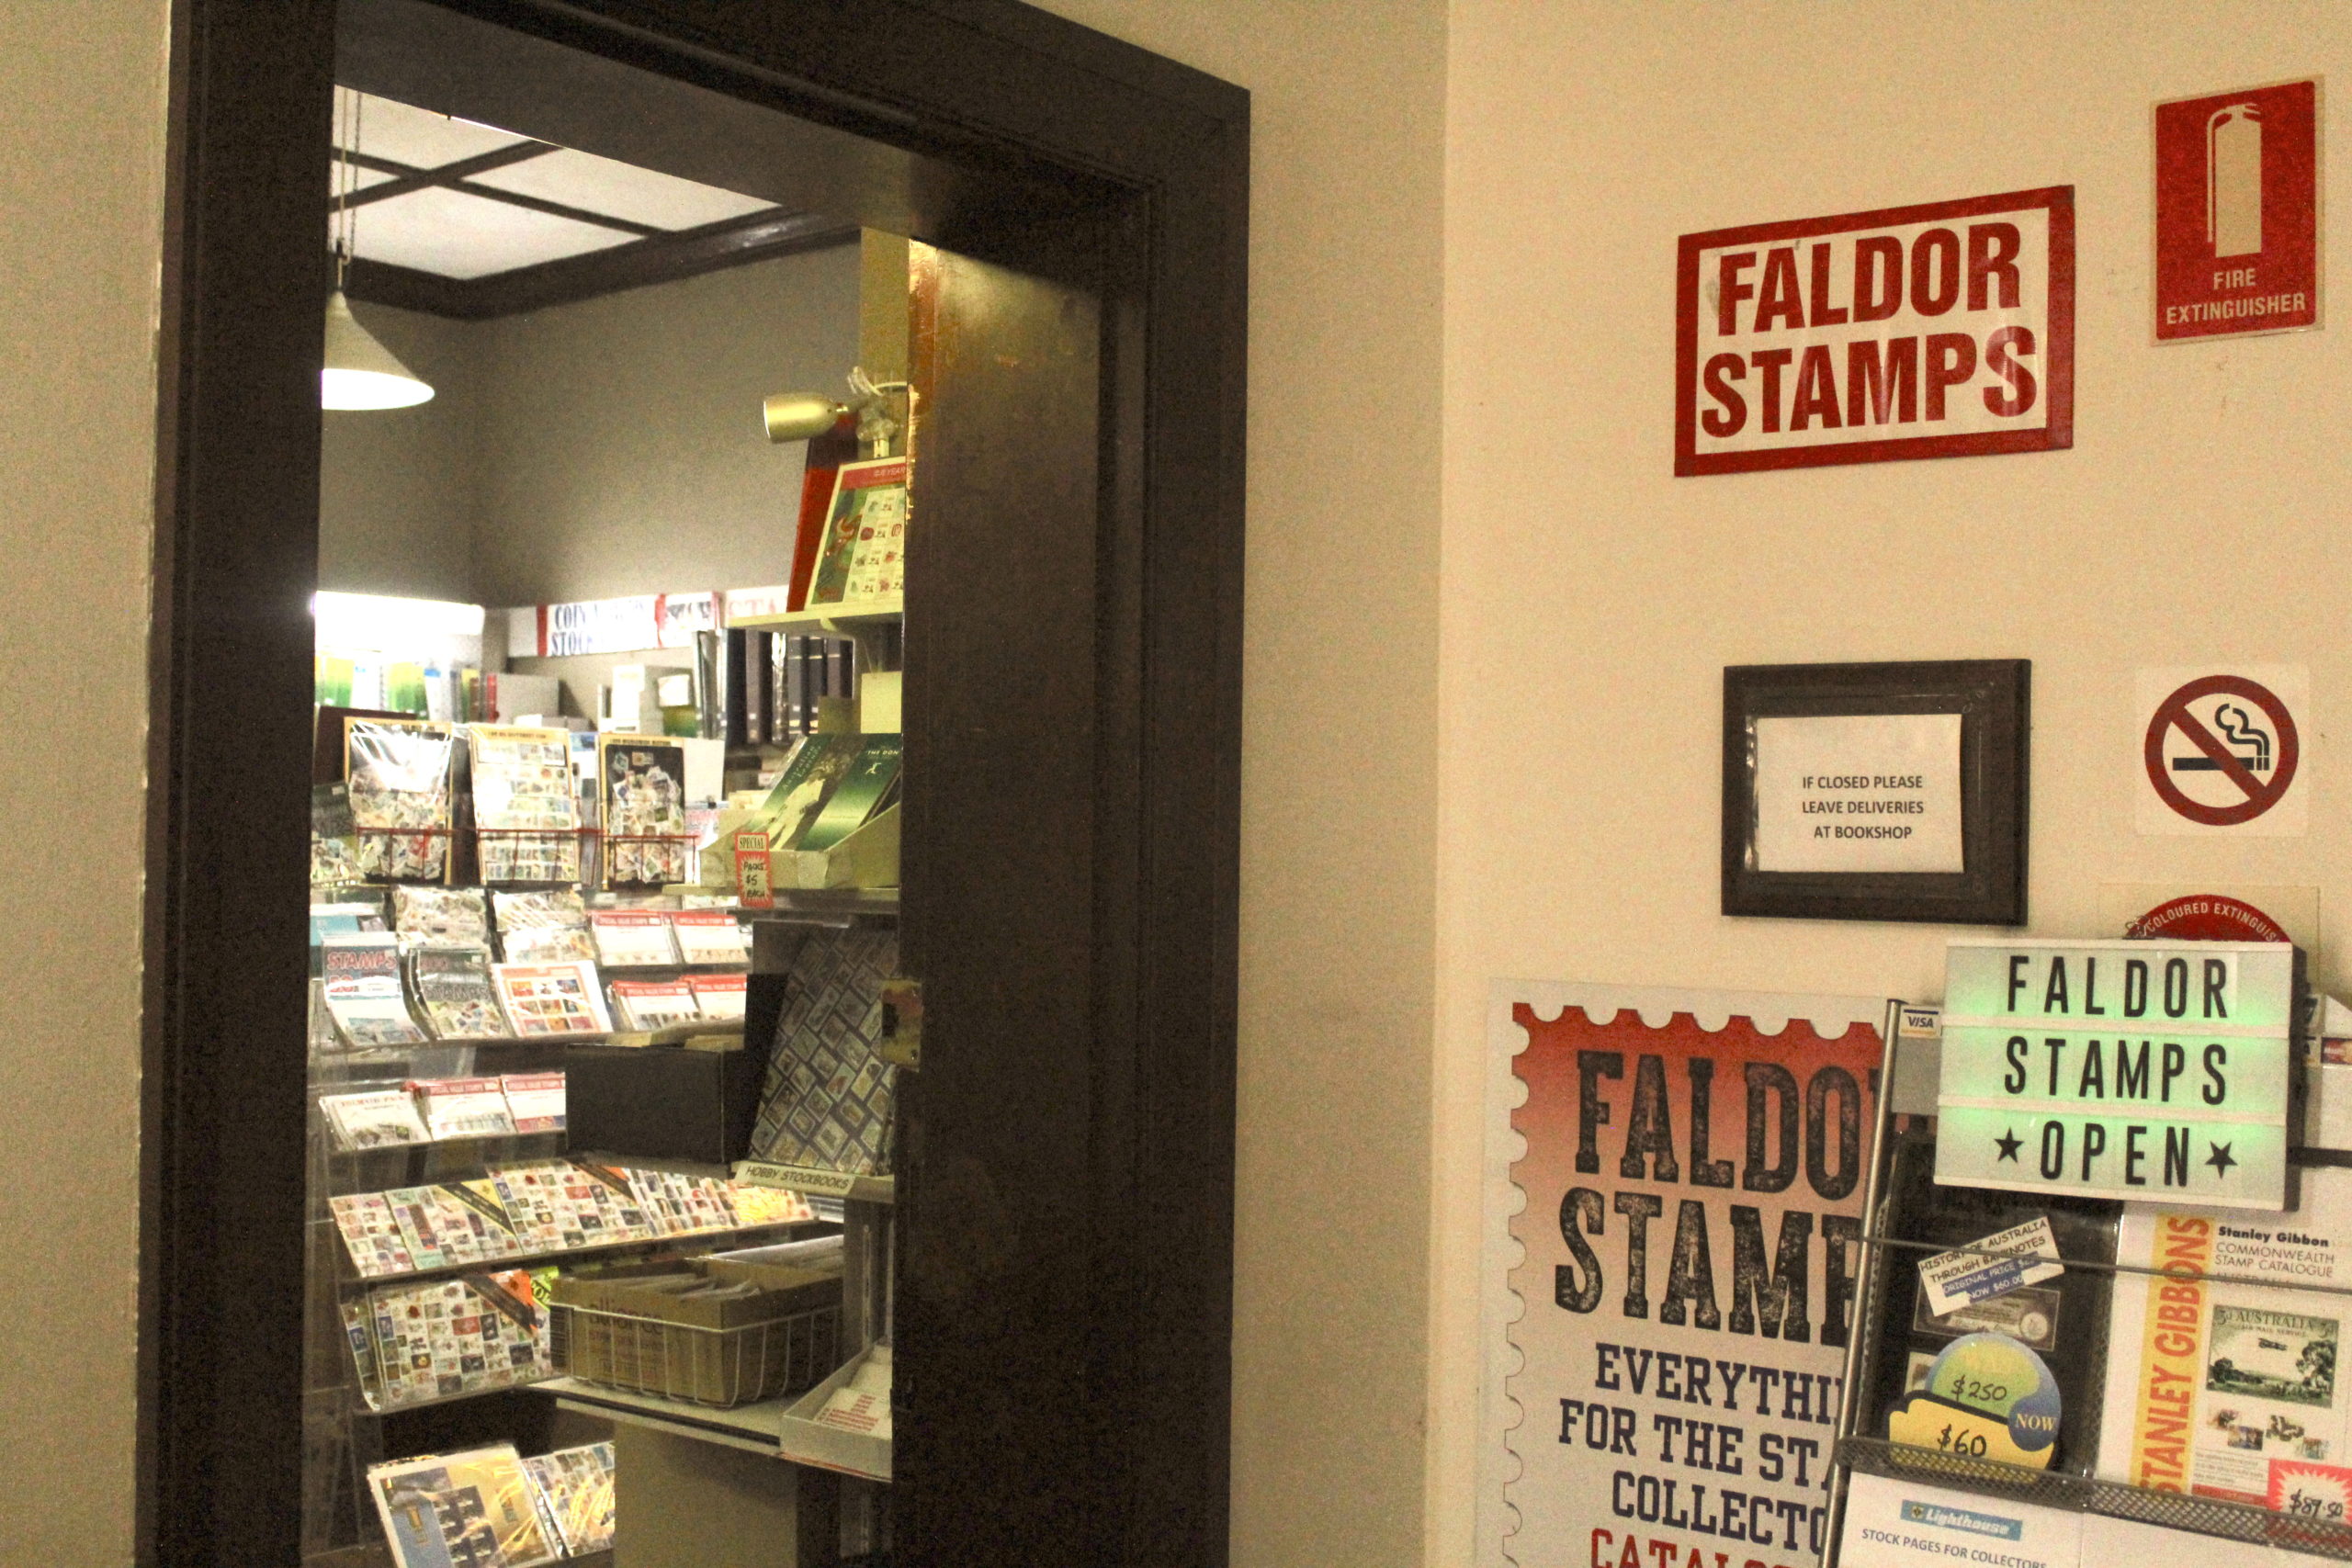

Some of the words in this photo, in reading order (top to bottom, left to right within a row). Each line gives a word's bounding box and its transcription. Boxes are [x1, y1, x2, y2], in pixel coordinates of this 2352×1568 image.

[1717, 221, 2022, 337] FALDOR
[2213, 268, 2256, 290] FIRE
[2166, 292, 2306, 325] EXTINGUISHER
[1701, 325, 2038, 439] STAMPS
[1803, 776, 1815, 789] IF
[1817, 775, 1870, 789] CLOSED
[1873, 775, 1923, 789] PLEASE
[1802, 801, 1844, 814] LEAVE
[1847, 801, 1924, 814] DELIVERIES
[739, 837, 764, 850] SPECIAL
[1814, 826, 1831, 839] AT
[1835, 826, 1912, 840] BOOKSHOP
[2147, 902, 2209, 933] COLOURED
[2007, 954, 2228, 1020] FALDOR
[1907, 1016, 1934, 1028] VISA
[2004, 1035, 2227, 1106] STAMPS
[1575, 1049, 1878, 1201] FALDO
[2040, 1120, 2190, 1188] OPEN
[745, 1165, 780, 1179] HOBBY
[780, 1170, 850, 1190] STOCKBOOKS
[1920, 1249, 1965, 1272] HISTORY
[1987, 1218, 2049, 1248] AUSTRALIA
[2218, 1225, 2271, 1244] Stanley
[2276, 1232, 2329, 1247] Gibbon
[2215, 1254, 2254, 1269] STAMP
[2258, 1259, 2334, 1279] CATALOGUE
[2216, 1242, 2335, 1265] COMMONWEALTH
[1929, 1260, 1980, 1284] THROUGH
[1943, 1272, 1988, 1294] ORIGINAL
[1989, 1263, 2016, 1278] PRICE
[1968, 1286, 1990, 1300] NOW
[2153, 1217, 2211, 1359] GIBBONS
[2235, 1311, 2314, 1331] AUSTRALIA
[1950, 1374, 2007, 1403] $250
[2014, 1413, 2056, 1432] NOW
[1558, 1397, 1637, 1457] FOR
[1654, 1414, 1743, 1475] THE
[1758, 1432, 1829, 1492] ST
[1937, 1424, 1987, 1458] $60
[1926, 1508, 2010, 1536] Lighthouse
[1861, 1528, 1900, 1546] STOCK
[1903, 1536, 1941, 1554] PAGES
[1944, 1544, 1968, 1559] FOR
